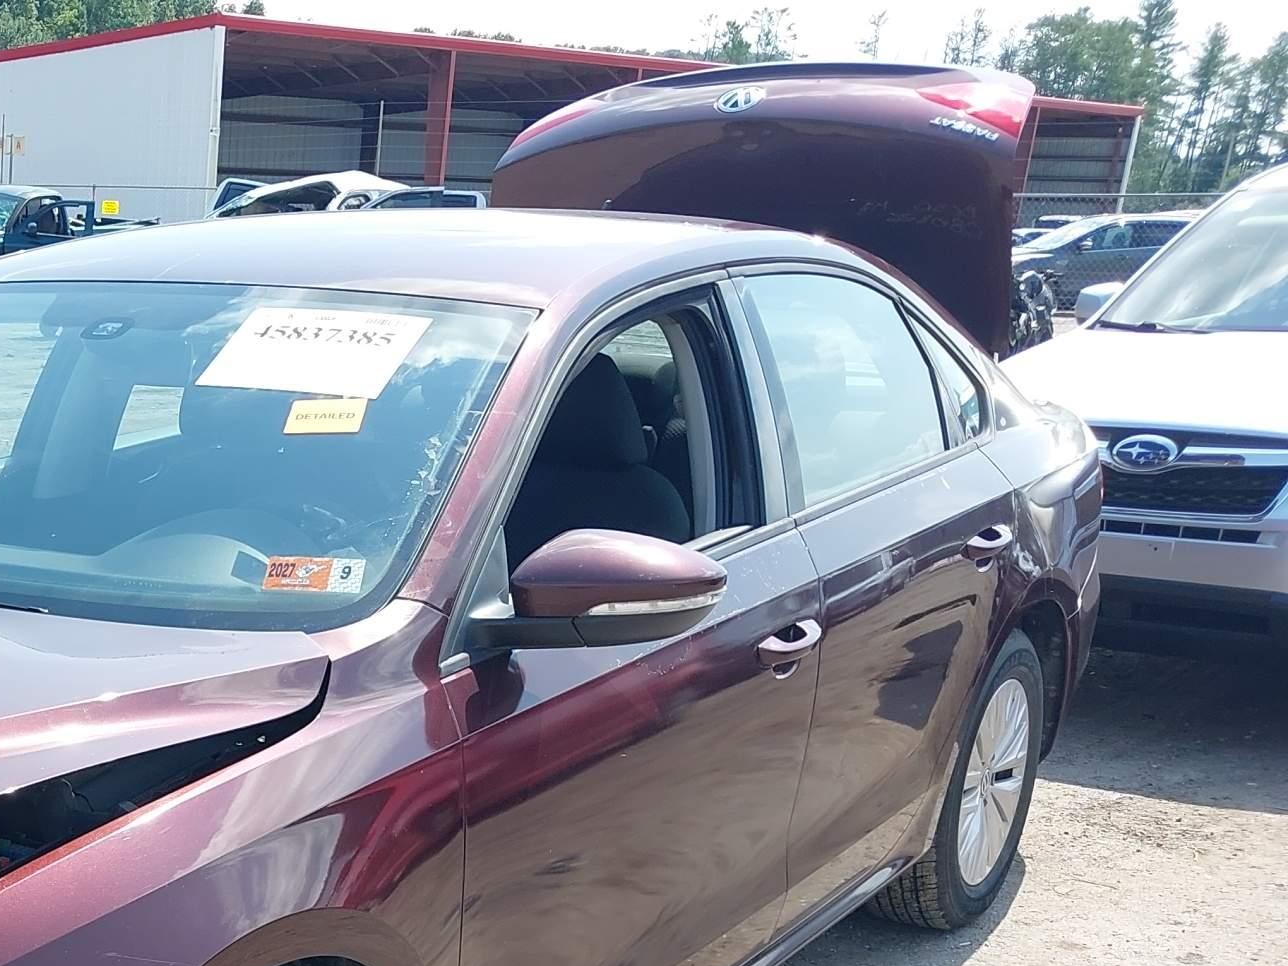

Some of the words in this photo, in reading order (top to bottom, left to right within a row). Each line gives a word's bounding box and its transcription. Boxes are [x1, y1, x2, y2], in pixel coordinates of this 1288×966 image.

[253, 324, 397, 347] 45837385
[295, 411, 356, 422] DETAILED
[268, 562, 297, 578] 2027
[340, 565, 353, 580] 9
